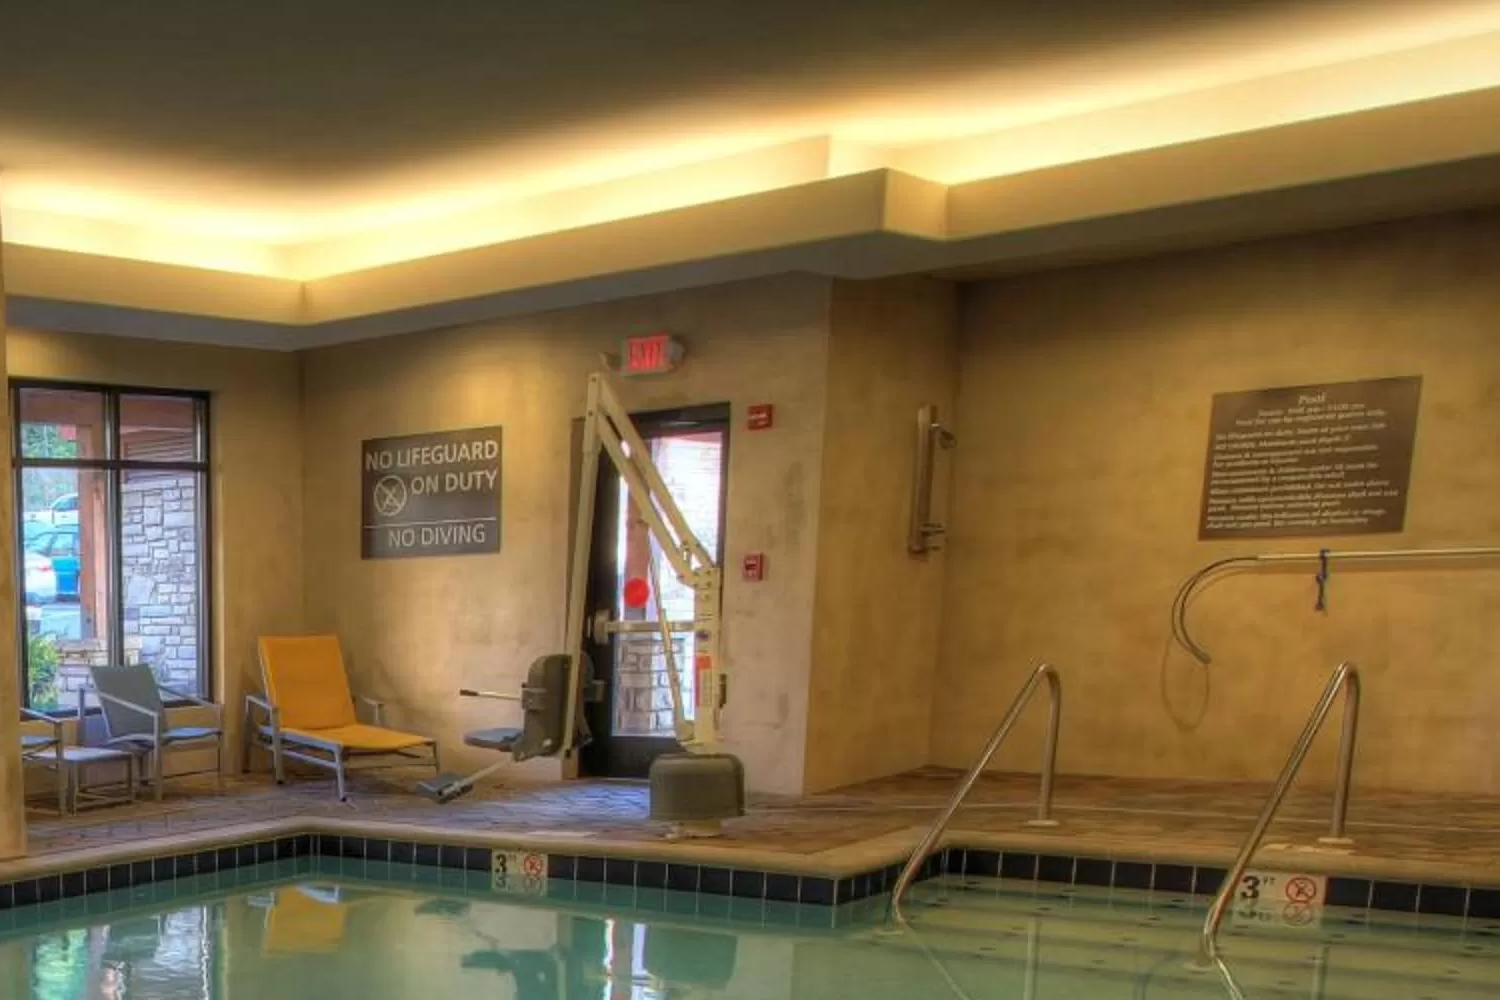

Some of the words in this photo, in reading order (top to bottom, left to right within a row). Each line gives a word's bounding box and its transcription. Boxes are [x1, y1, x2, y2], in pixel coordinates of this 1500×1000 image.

[365, 451, 393, 472] NO
[398, 440, 498, 467] LIFEGUARD
[411, 474, 439, 495] ON
[445, 467, 498, 492] DUTY
[387, 527, 416, 548] NO
[421, 523, 485, 546] DIVING
[495, 854, 507, 873] 3
[1240, 876, 1260, 899] 3
